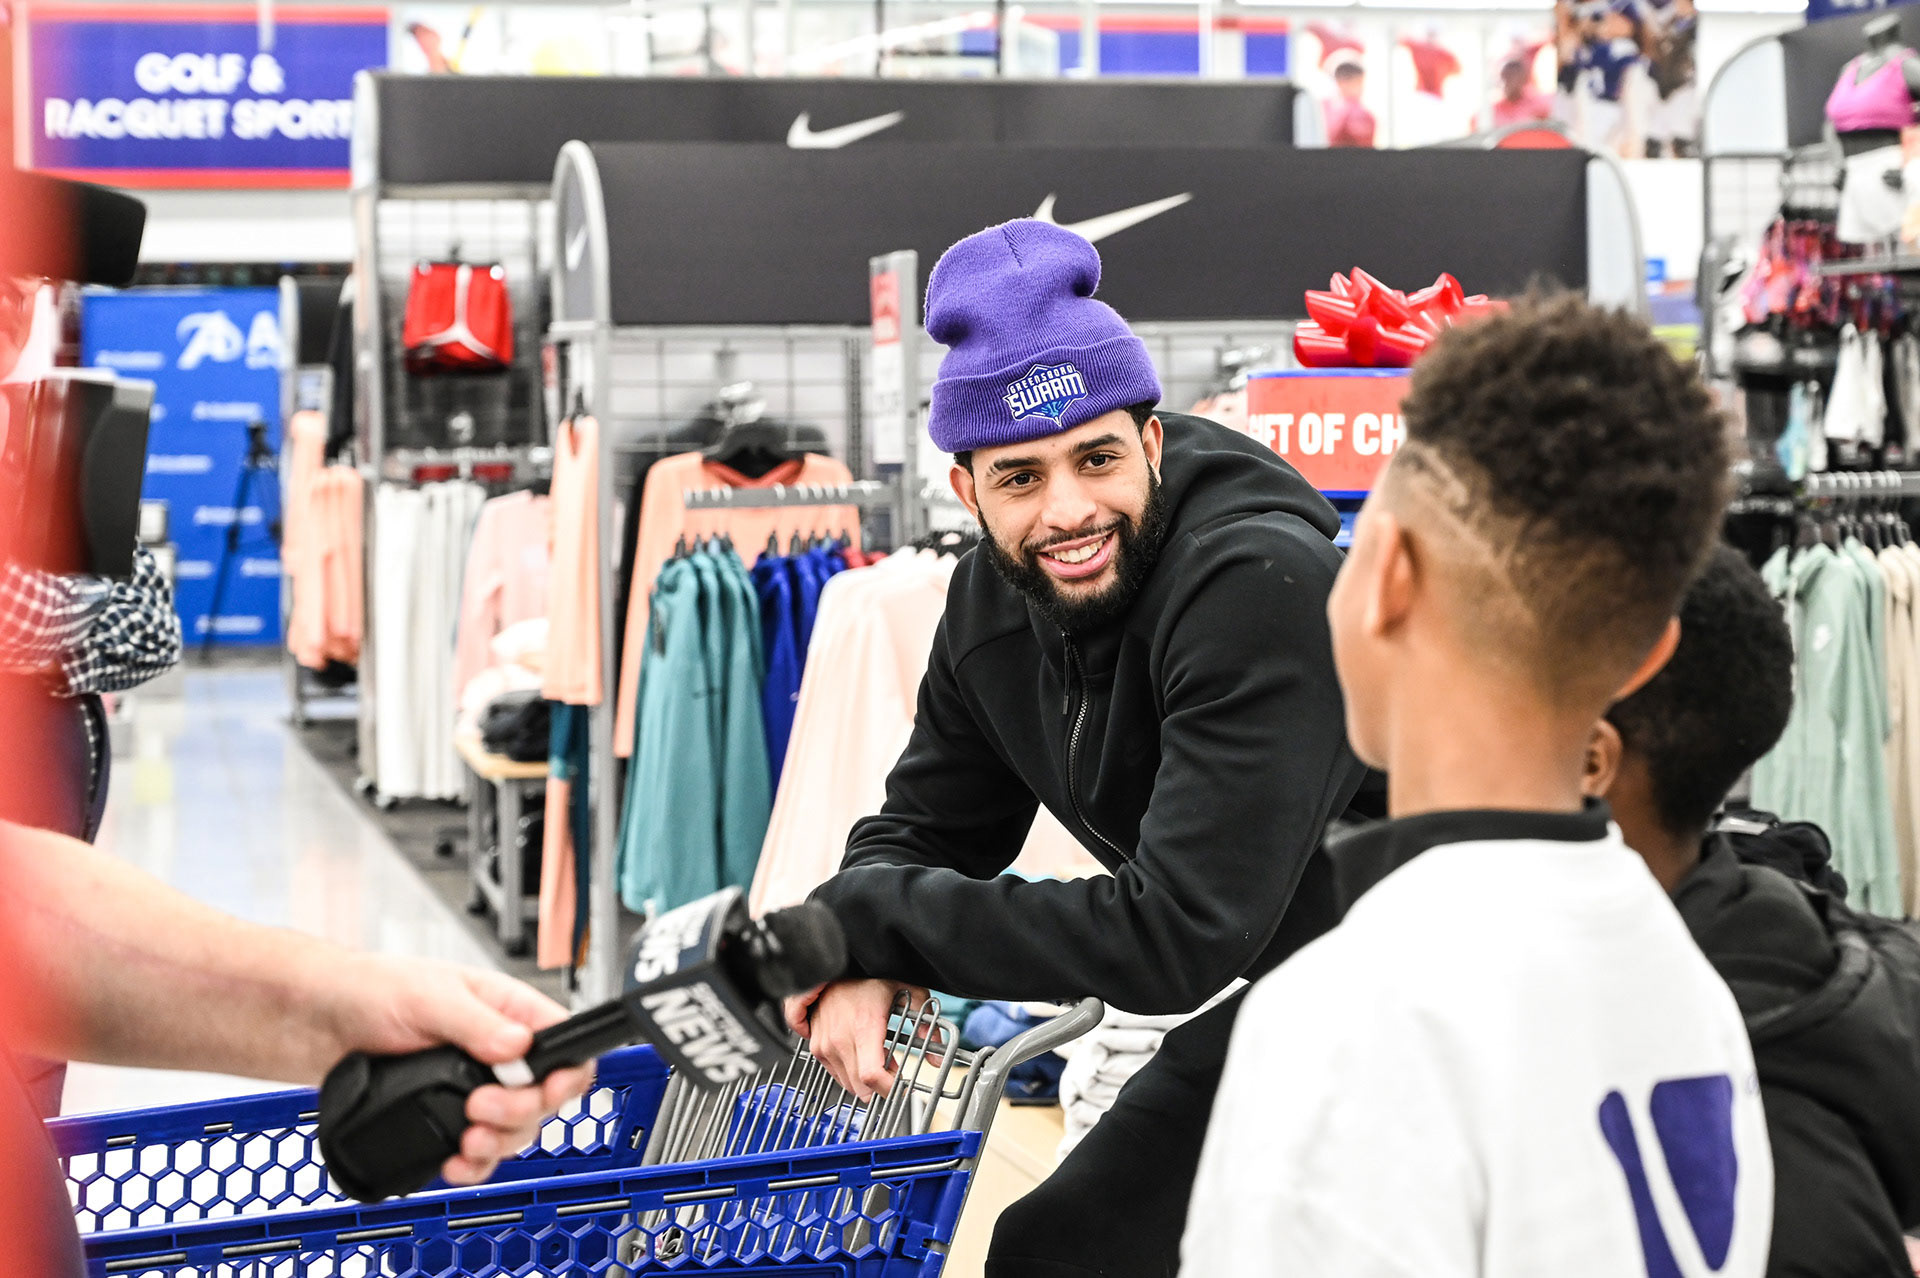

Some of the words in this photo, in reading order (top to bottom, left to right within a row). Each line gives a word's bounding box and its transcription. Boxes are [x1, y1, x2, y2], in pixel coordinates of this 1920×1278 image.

[135, 52, 245, 94] GOLF
[248, 53, 285, 94] &
[44, 97, 229, 139] RACQUET
[232, 97, 352, 139] SPORT
[1008, 373, 1086, 417] SWARM
[1009, 365, 1074, 394] GREENSBORO
[1298, 412, 1345, 455] OF
[641, 986, 759, 1084] NEWS
